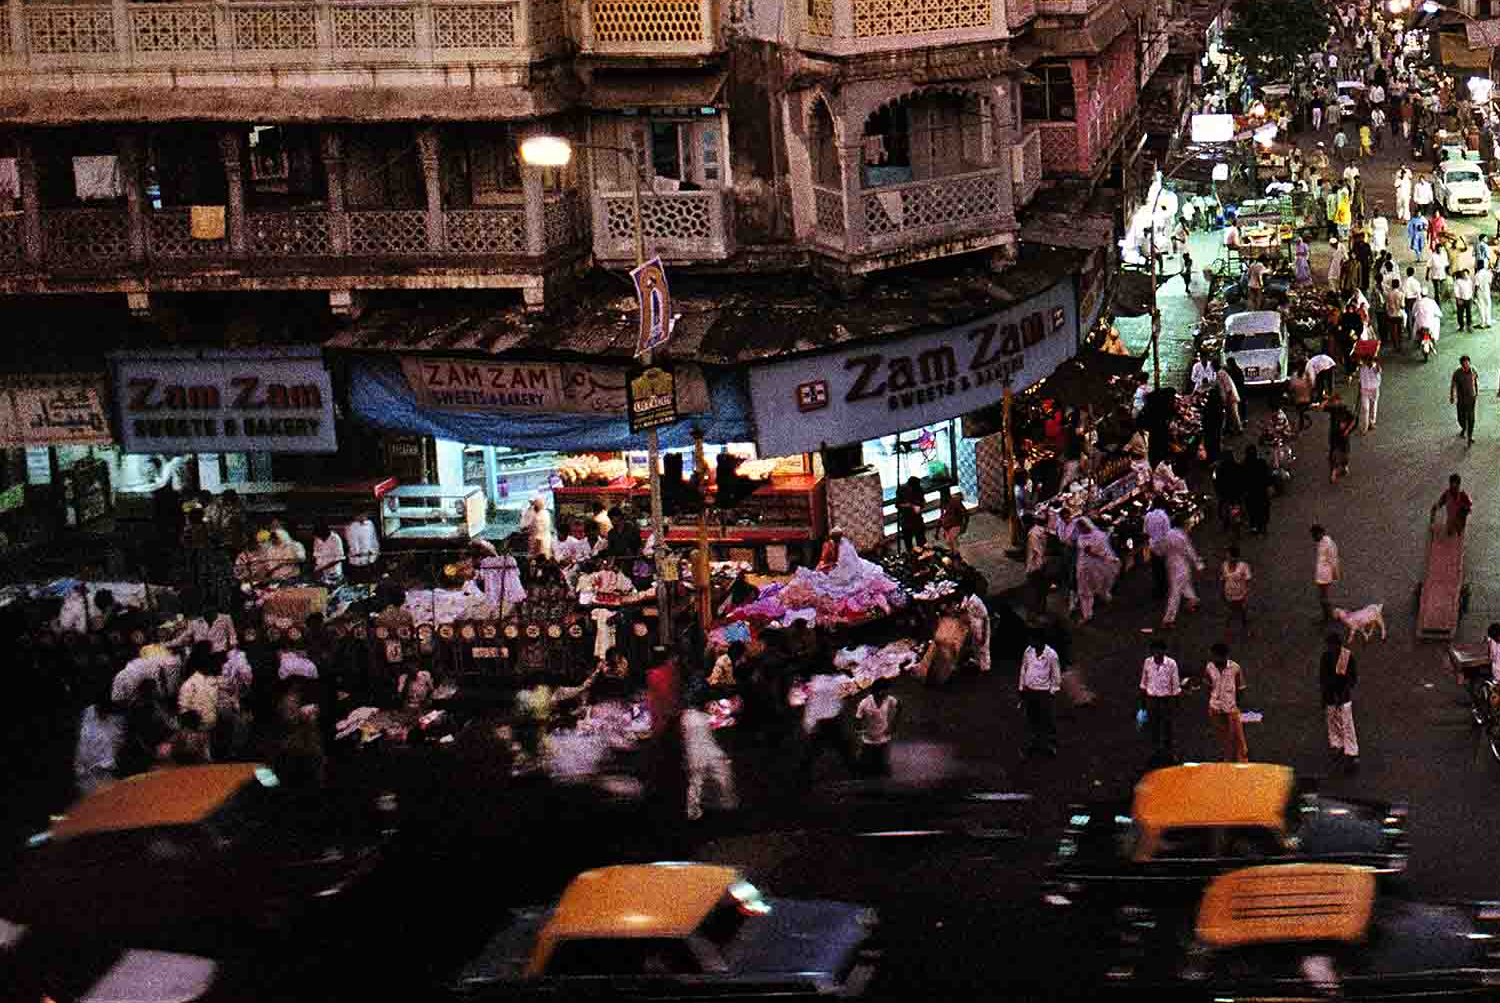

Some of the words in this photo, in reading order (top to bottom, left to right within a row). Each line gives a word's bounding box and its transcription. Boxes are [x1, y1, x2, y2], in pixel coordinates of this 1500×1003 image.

[846, 348, 957, 403] Zam
[969, 312, 1046, 370] Zam
[128, 377, 220, 409] Zam
[231, 376, 322, 410] Zam
[428, 364, 483, 387] ZAM
[491, 367, 549, 389] ZAM
